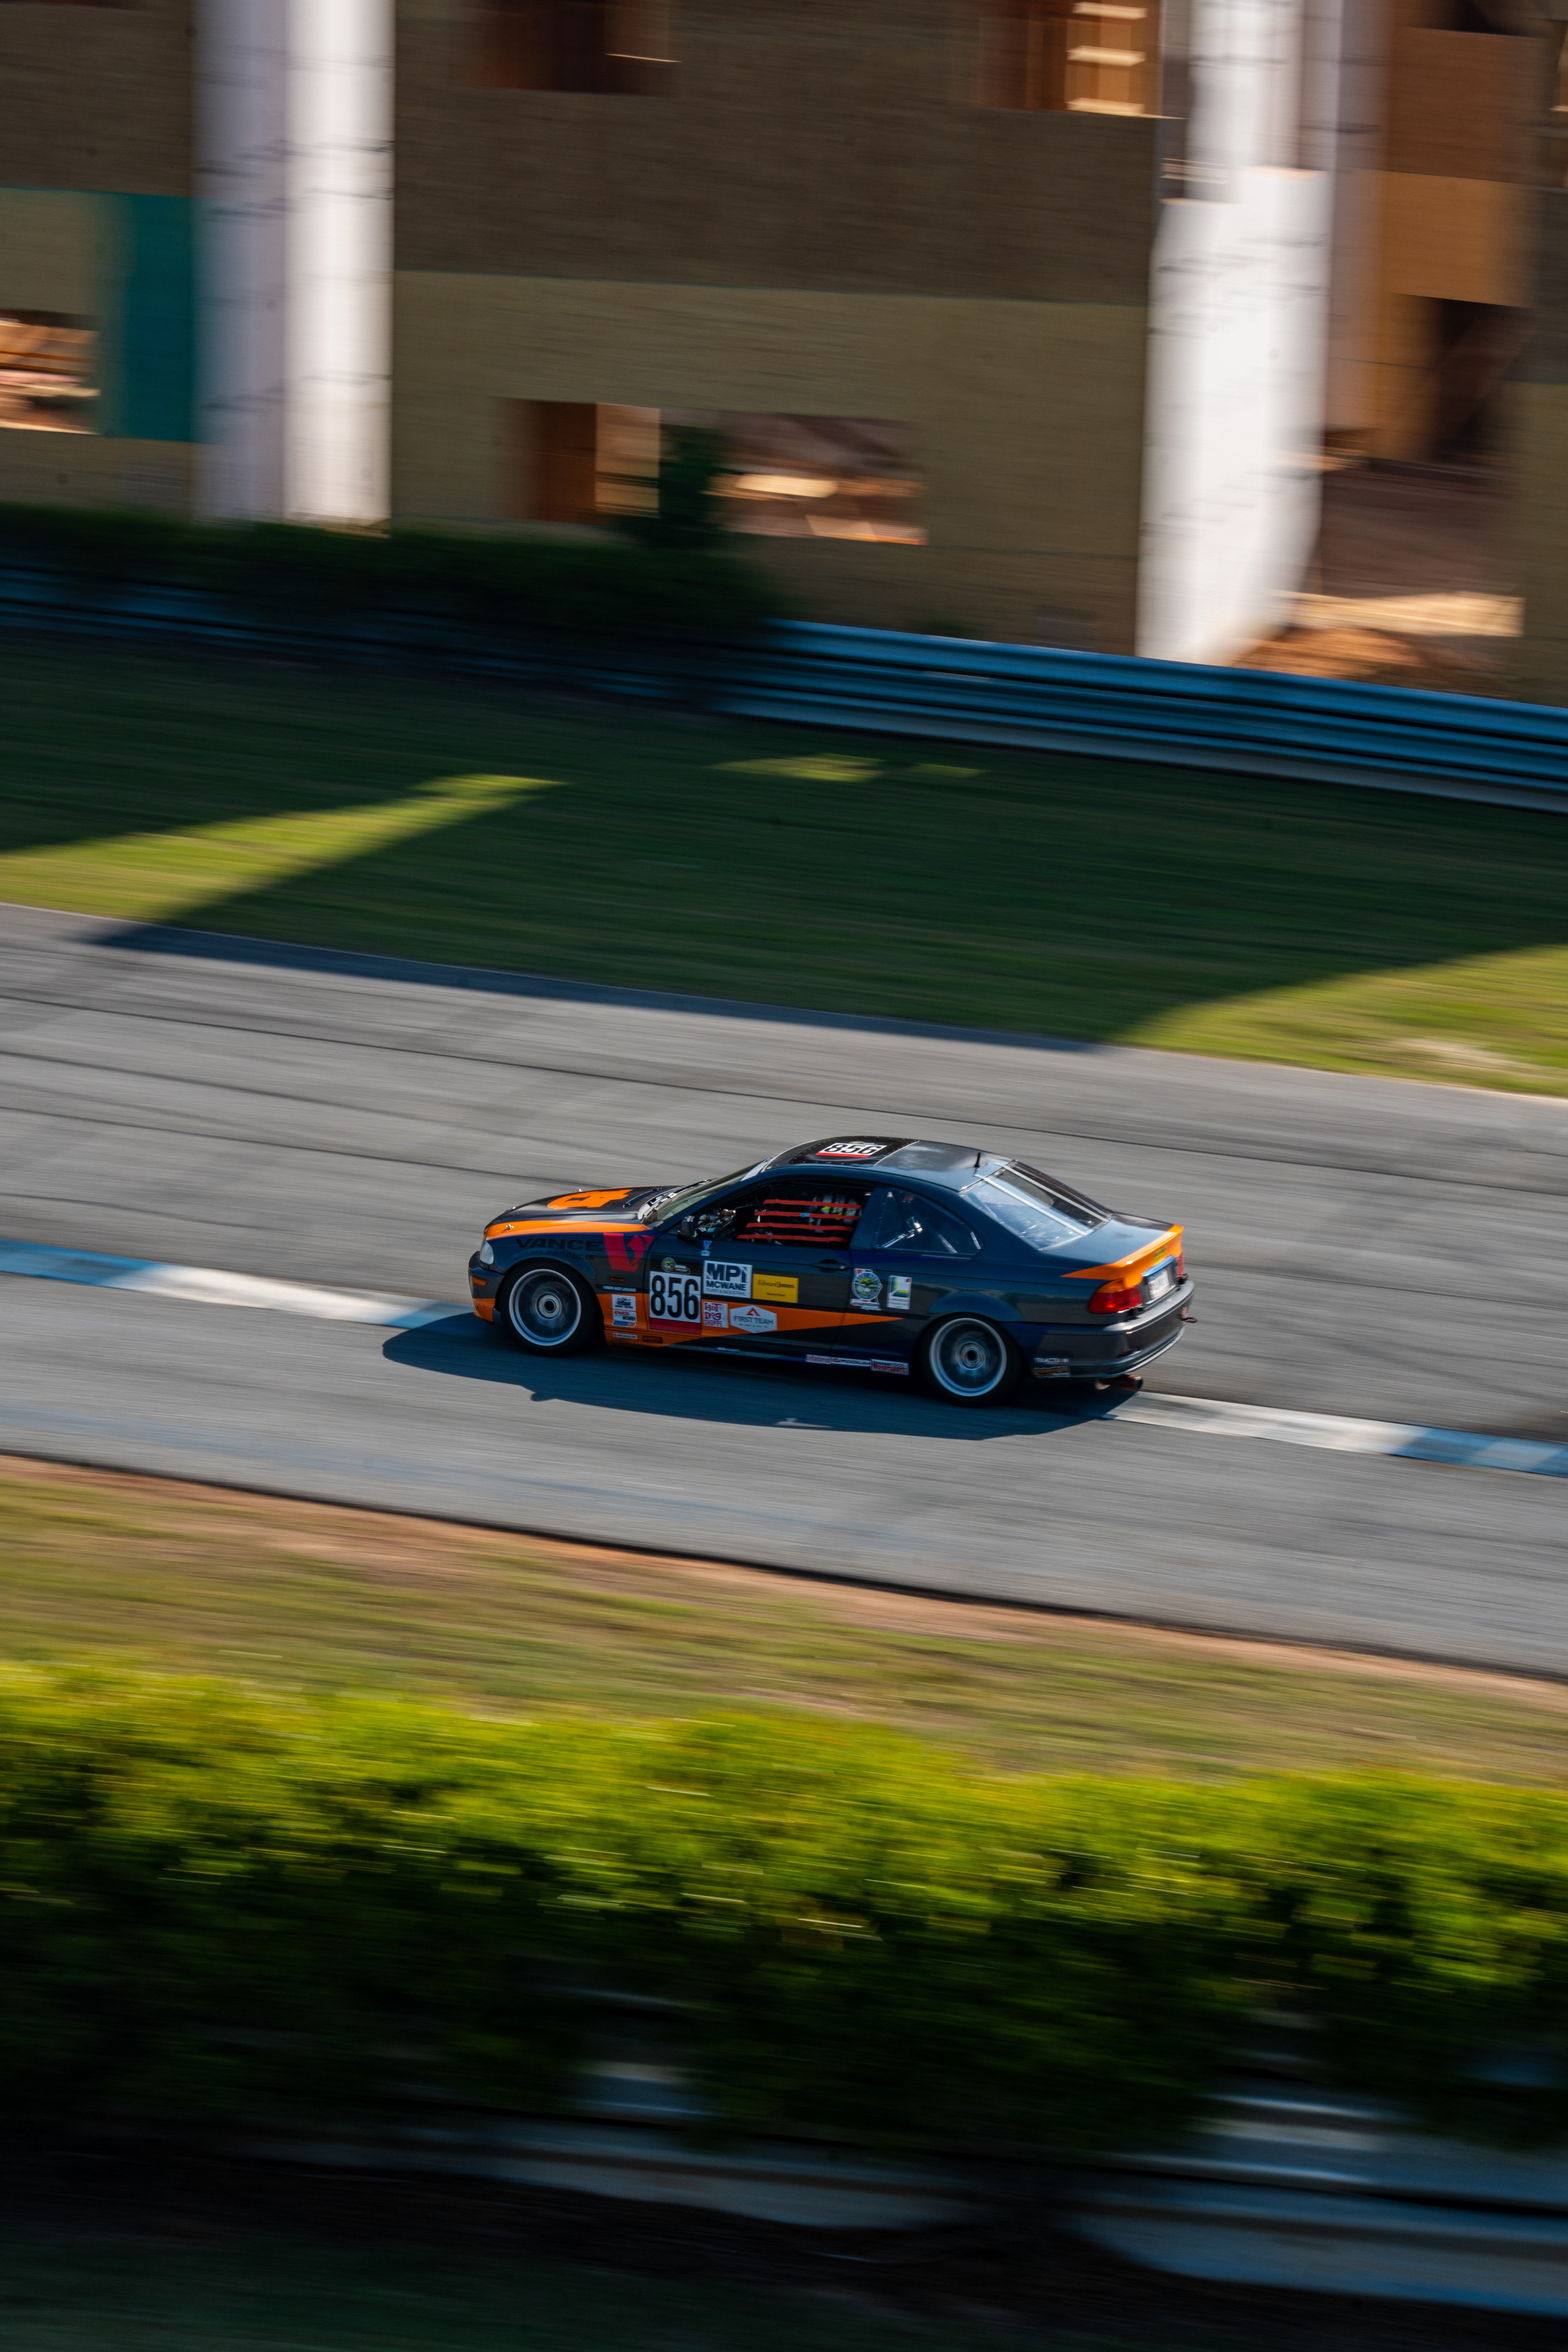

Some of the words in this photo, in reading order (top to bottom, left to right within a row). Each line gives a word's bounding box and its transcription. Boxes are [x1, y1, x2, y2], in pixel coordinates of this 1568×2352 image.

[824, 1144, 881, 1154] 856
[515, 1238, 603, 1252] VANCE
[547, 1250, 595, 1261] PRODUCTS
[706, 1280, 747, 1291] MCWANE
[650, 1275, 699, 1320] 856
